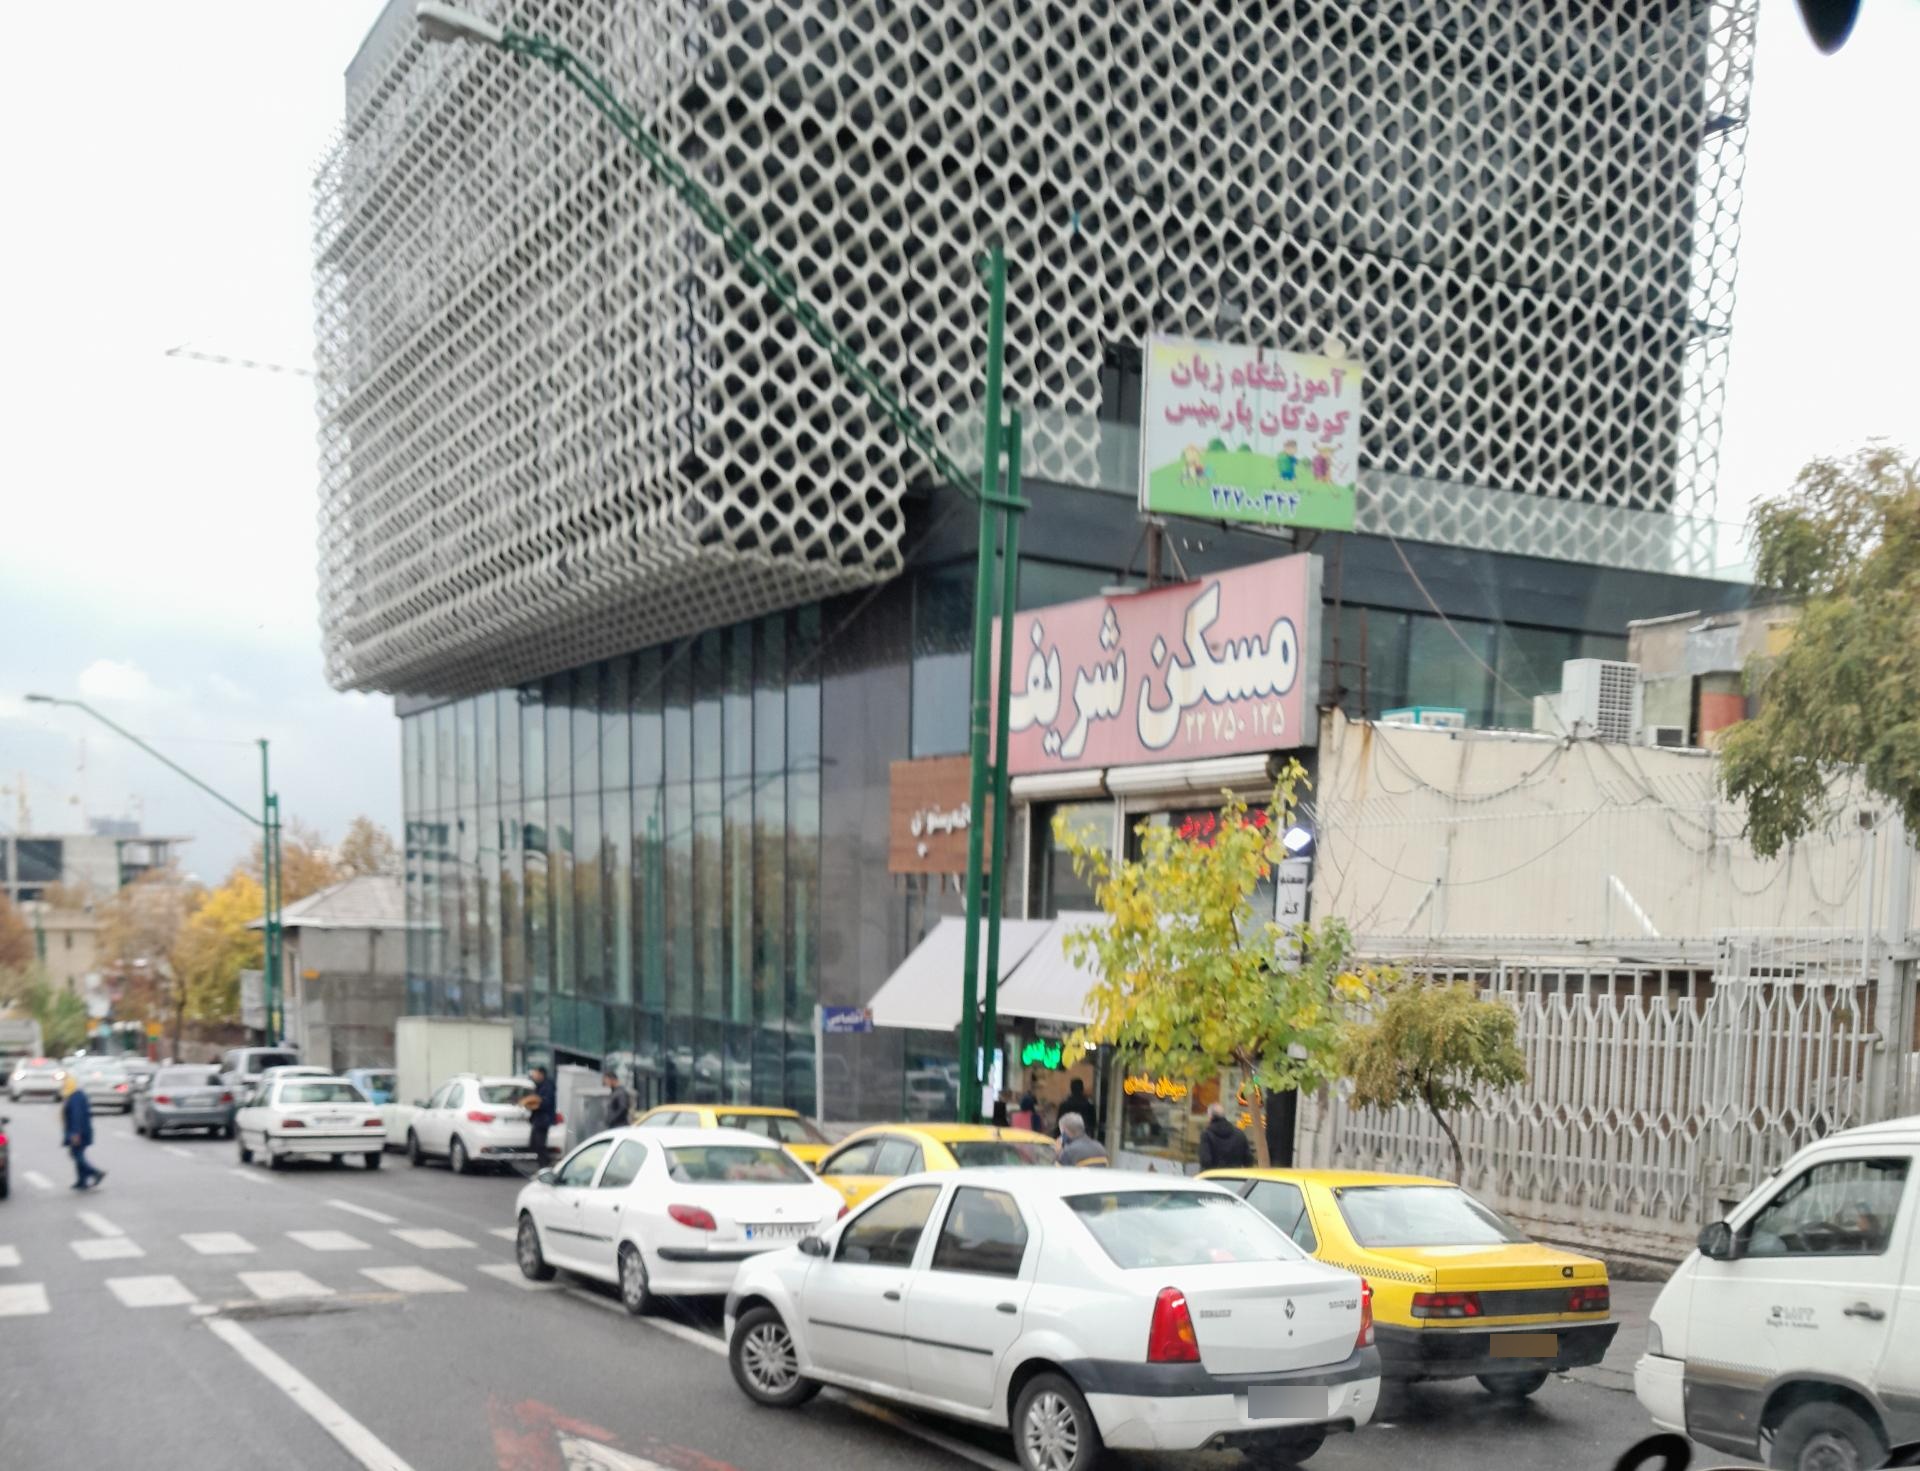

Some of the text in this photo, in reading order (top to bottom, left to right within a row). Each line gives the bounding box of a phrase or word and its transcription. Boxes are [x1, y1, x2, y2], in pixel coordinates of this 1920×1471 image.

[1170, 353, 1347, 403] آموزشگاه زبان
[1259, 403, 1350, 442] کودکان
[1009, 579, 1299, 760] مسکن شریف
